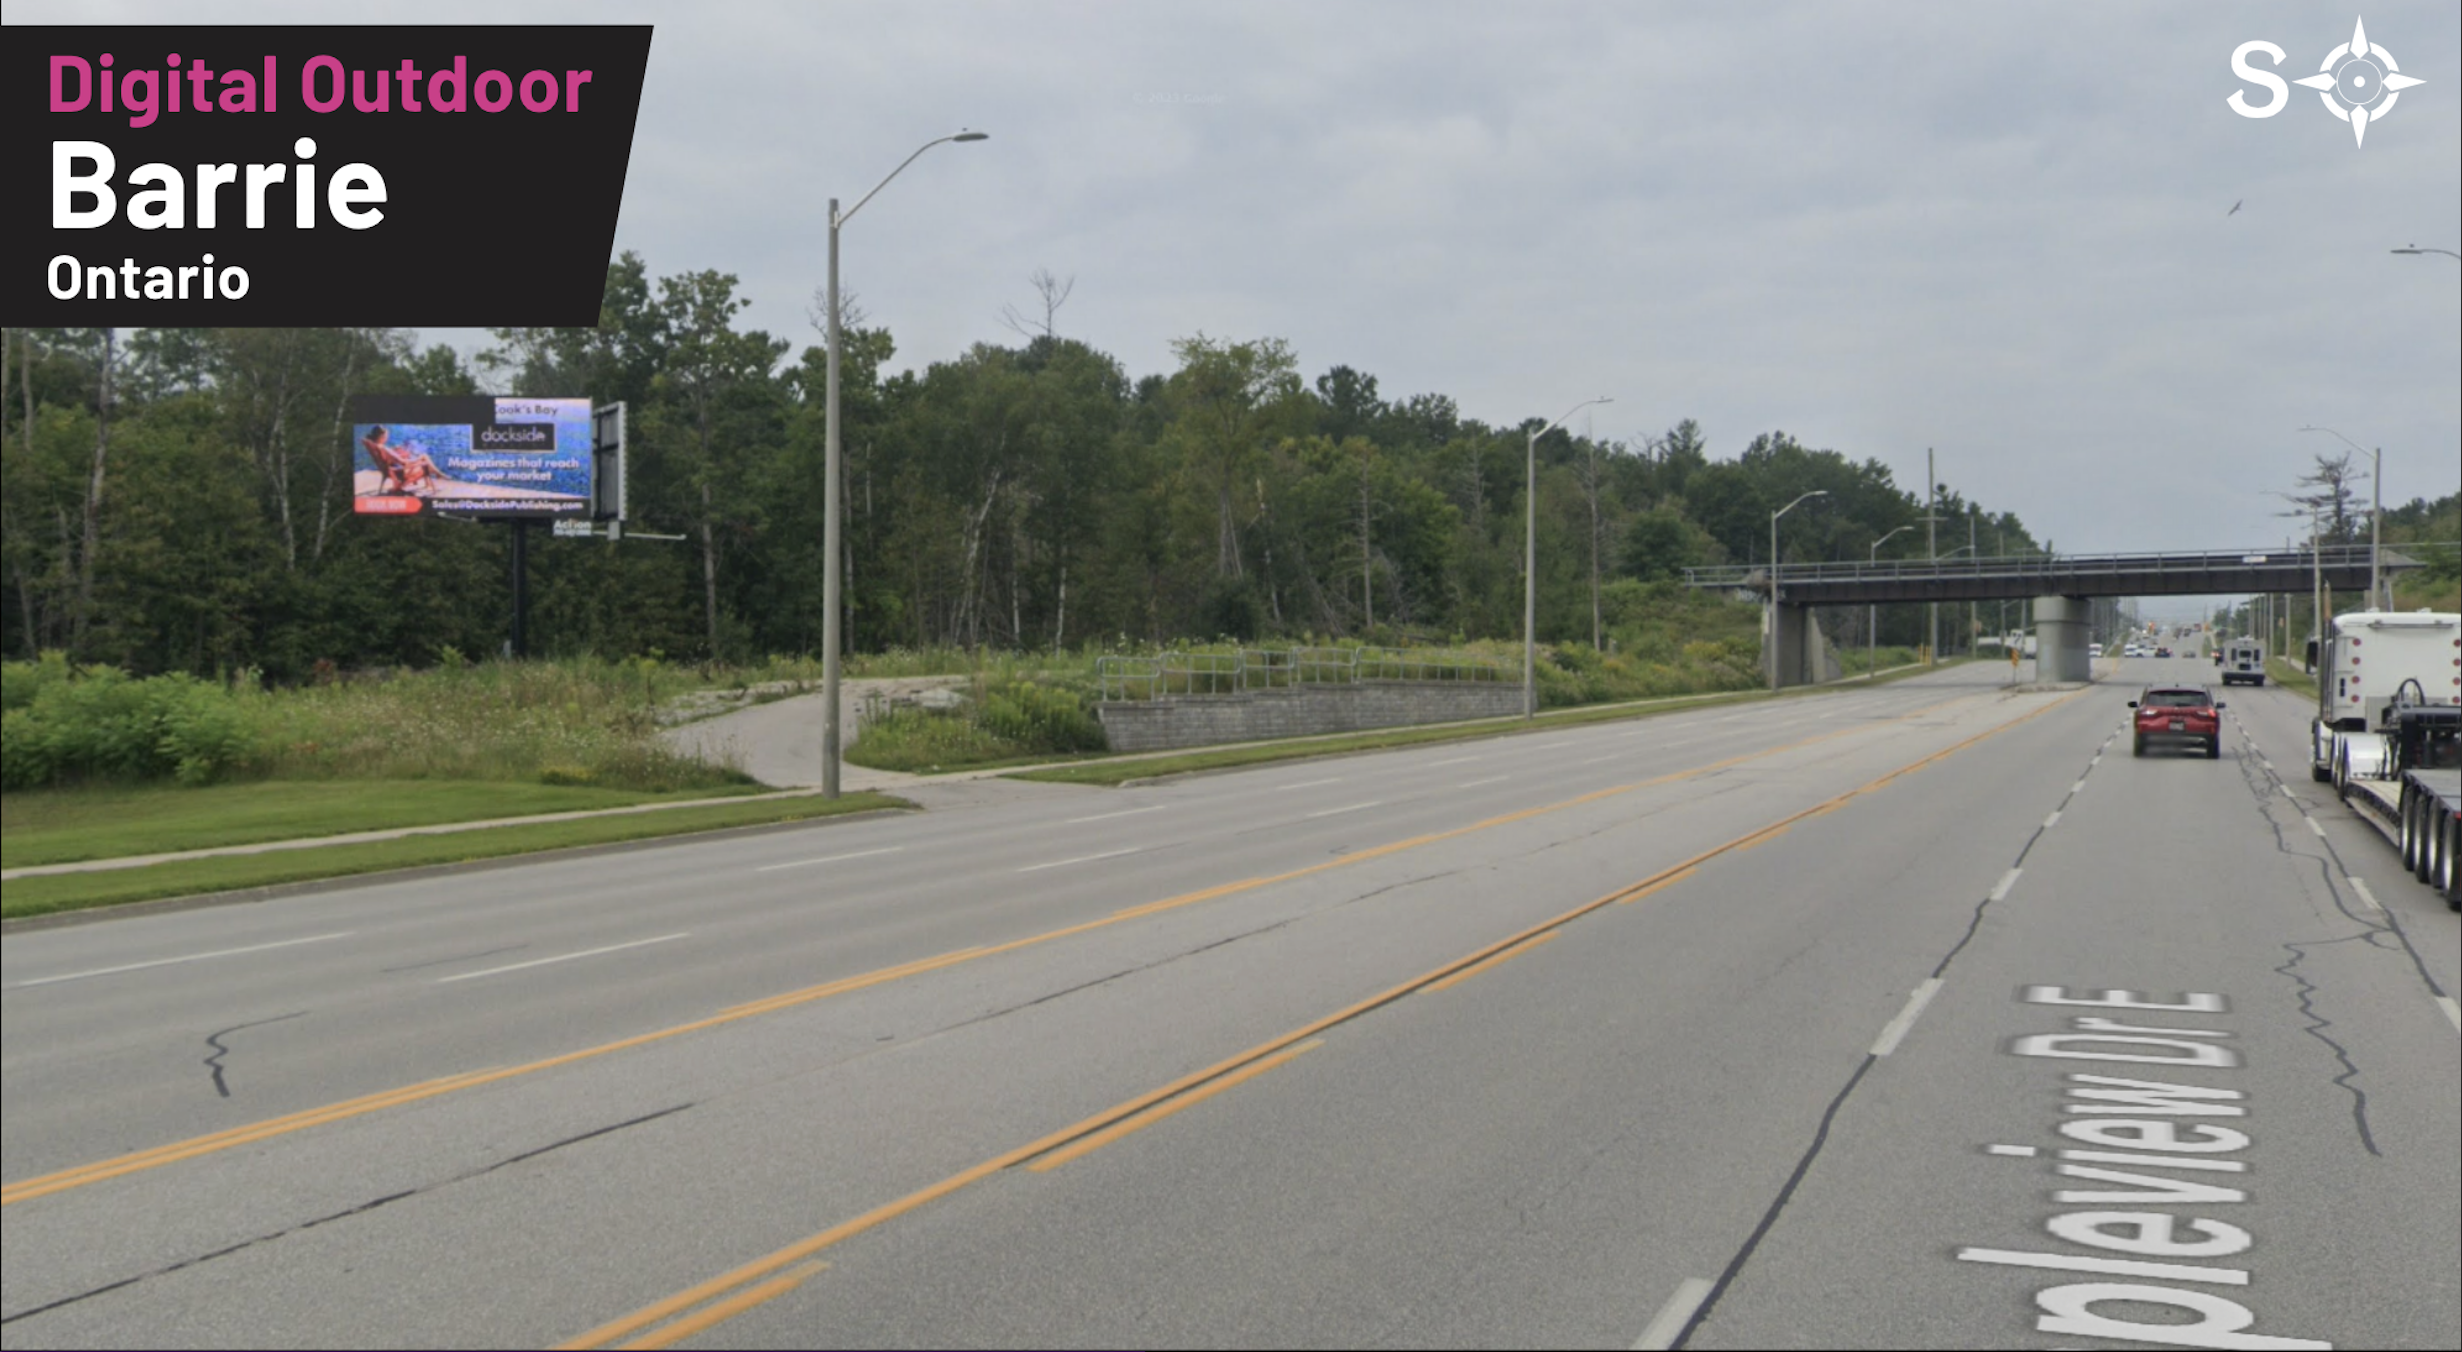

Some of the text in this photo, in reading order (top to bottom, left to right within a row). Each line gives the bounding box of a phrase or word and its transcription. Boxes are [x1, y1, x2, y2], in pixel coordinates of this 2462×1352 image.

[534, 404, 558, 416] Bay
[480, 425, 547, 443] dockside
[447, 456, 580, 471] Magazines that reach
[476, 469, 553, 483] your market
[431, 499, 584, 513] Sales@DocksidePublishing.com
